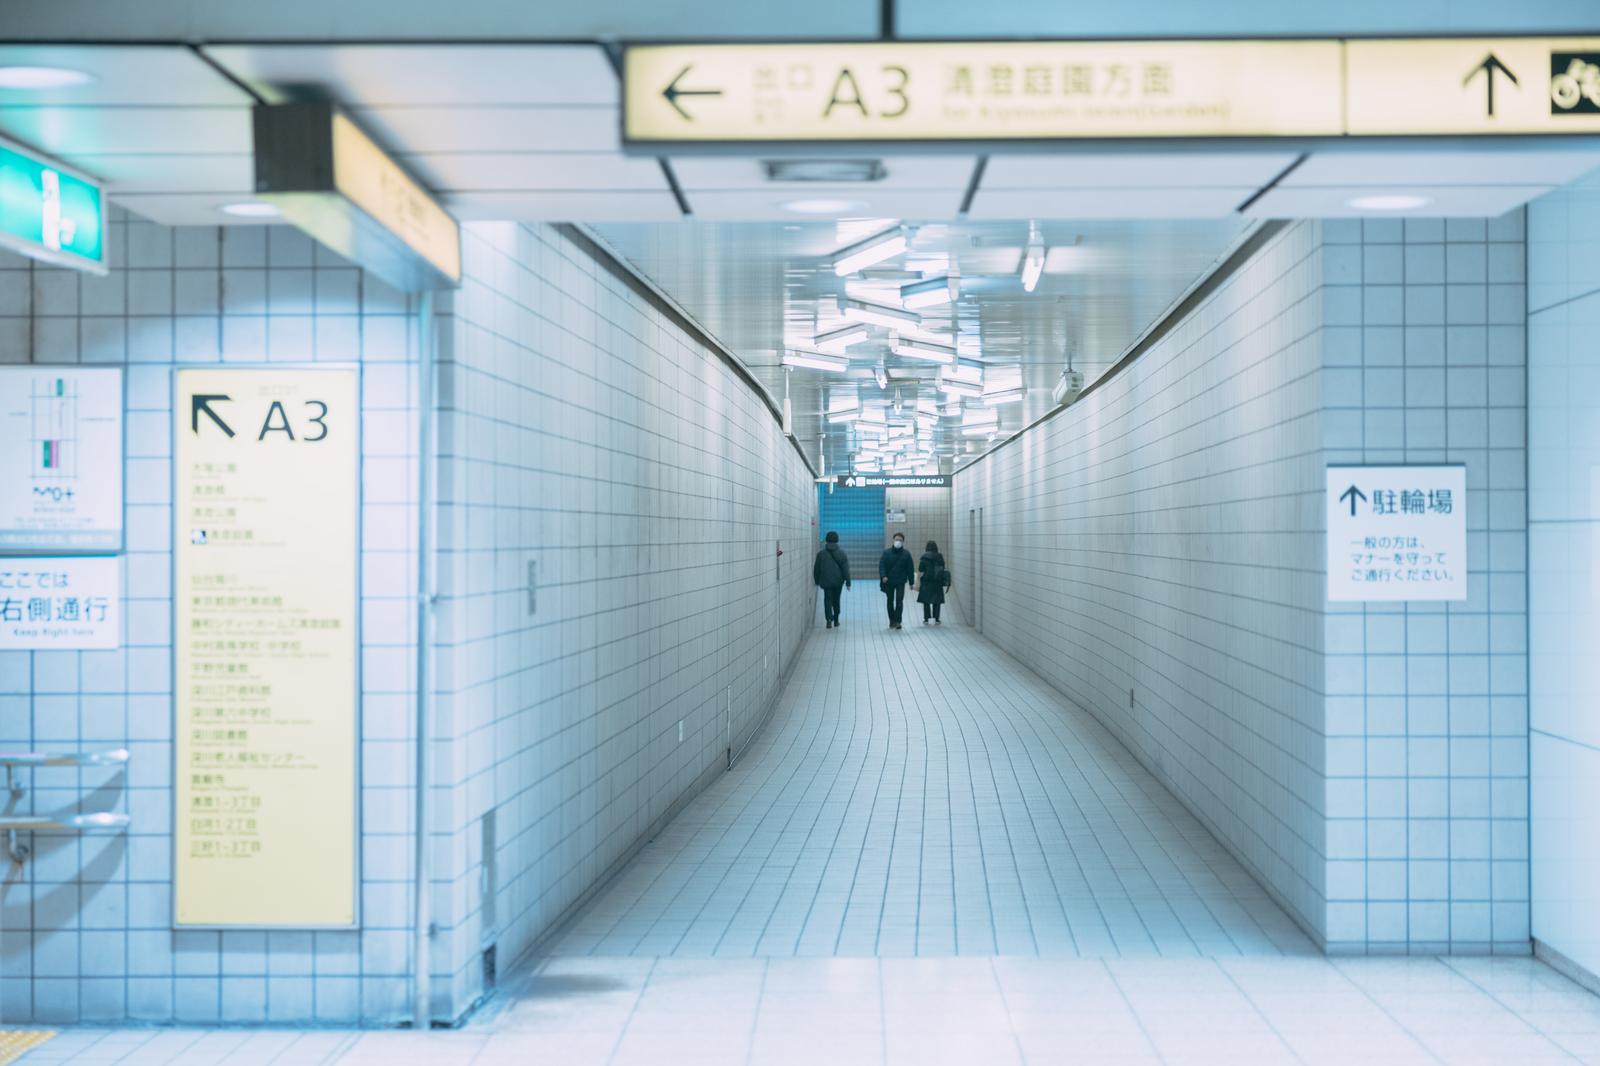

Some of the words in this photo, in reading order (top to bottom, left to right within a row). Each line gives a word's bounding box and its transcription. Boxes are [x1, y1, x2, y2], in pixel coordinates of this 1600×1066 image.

[821, 64, 909, 118] A3
[258, 400, 329, 442] A3
[1372, 489, 1453, 515] 駐輪場
[1350, 535, 1425, 550] 一般の方は、
[1350, 551, 1447, 566] マナーを守って
[0, 572, 69, 588] ここでは
[1350, 568, 1455, 583] ご通行ください。
[0, 597, 108, 622] 右側通行
